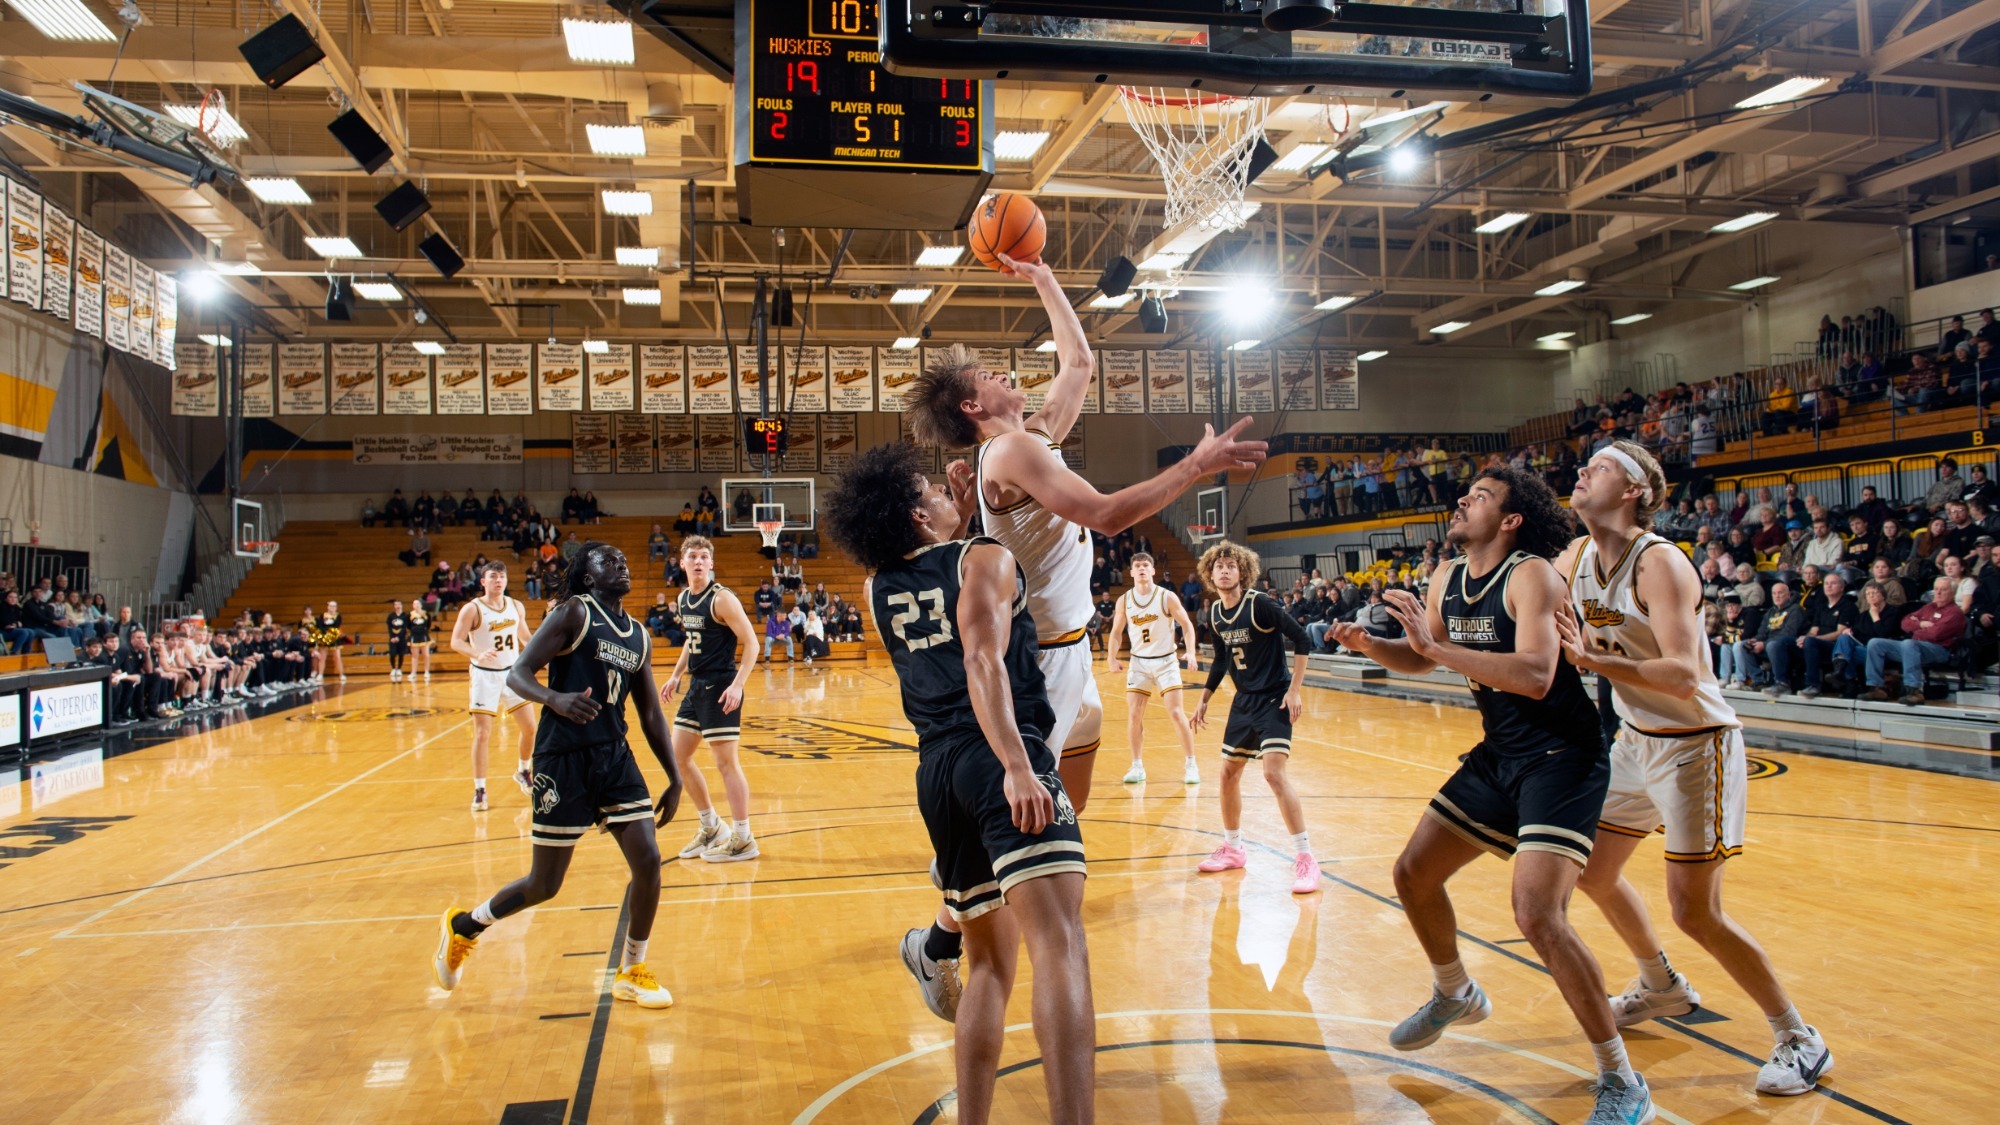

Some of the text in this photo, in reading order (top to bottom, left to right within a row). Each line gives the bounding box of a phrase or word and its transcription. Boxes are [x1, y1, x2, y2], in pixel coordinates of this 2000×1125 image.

[832, 0, 879, 33] 10:
[769, 37, 831, 56] HUSKIES
[847, 51, 879, 63] PERIO
[787, 61, 817, 92] 19
[870, 70, 876, 92] 1
[757, 98, 793, 110] FOULS
[830, 101, 905, 115] PLAYER FOUL
[940, 106, 975, 118] FOULS
[770, 112, 788, 139] 2
[956, 120, 970, 146] 3
[834, 147, 900, 158] MICHIGAN TECH
[1702, 421, 1716, 434] 25
[379, 437, 410, 445] Huskies
[1972, 431, 1984, 446] B
[364, 445, 407, 453] Basketball
[450, 445, 490, 454] Volleyball
[400, 453, 437, 461] Fan Zone
[485, 453, 521, 461] Fan Zone
[887, 587, 954, 653] 23
[1449, 618, 1493, 632] PURDUE
[494, 634, 514, 652] 24
[1142, 628, 1150, 644] 2
[1450, 630, 1497, 641] NORTHWEST
[600, 641, 640, 666] PURDUE
[1232, 647, 1247, 670] 2
[598, 651, 637, 672] NORTHWEST
[47, 693, 98, 720] SUPERIOR
